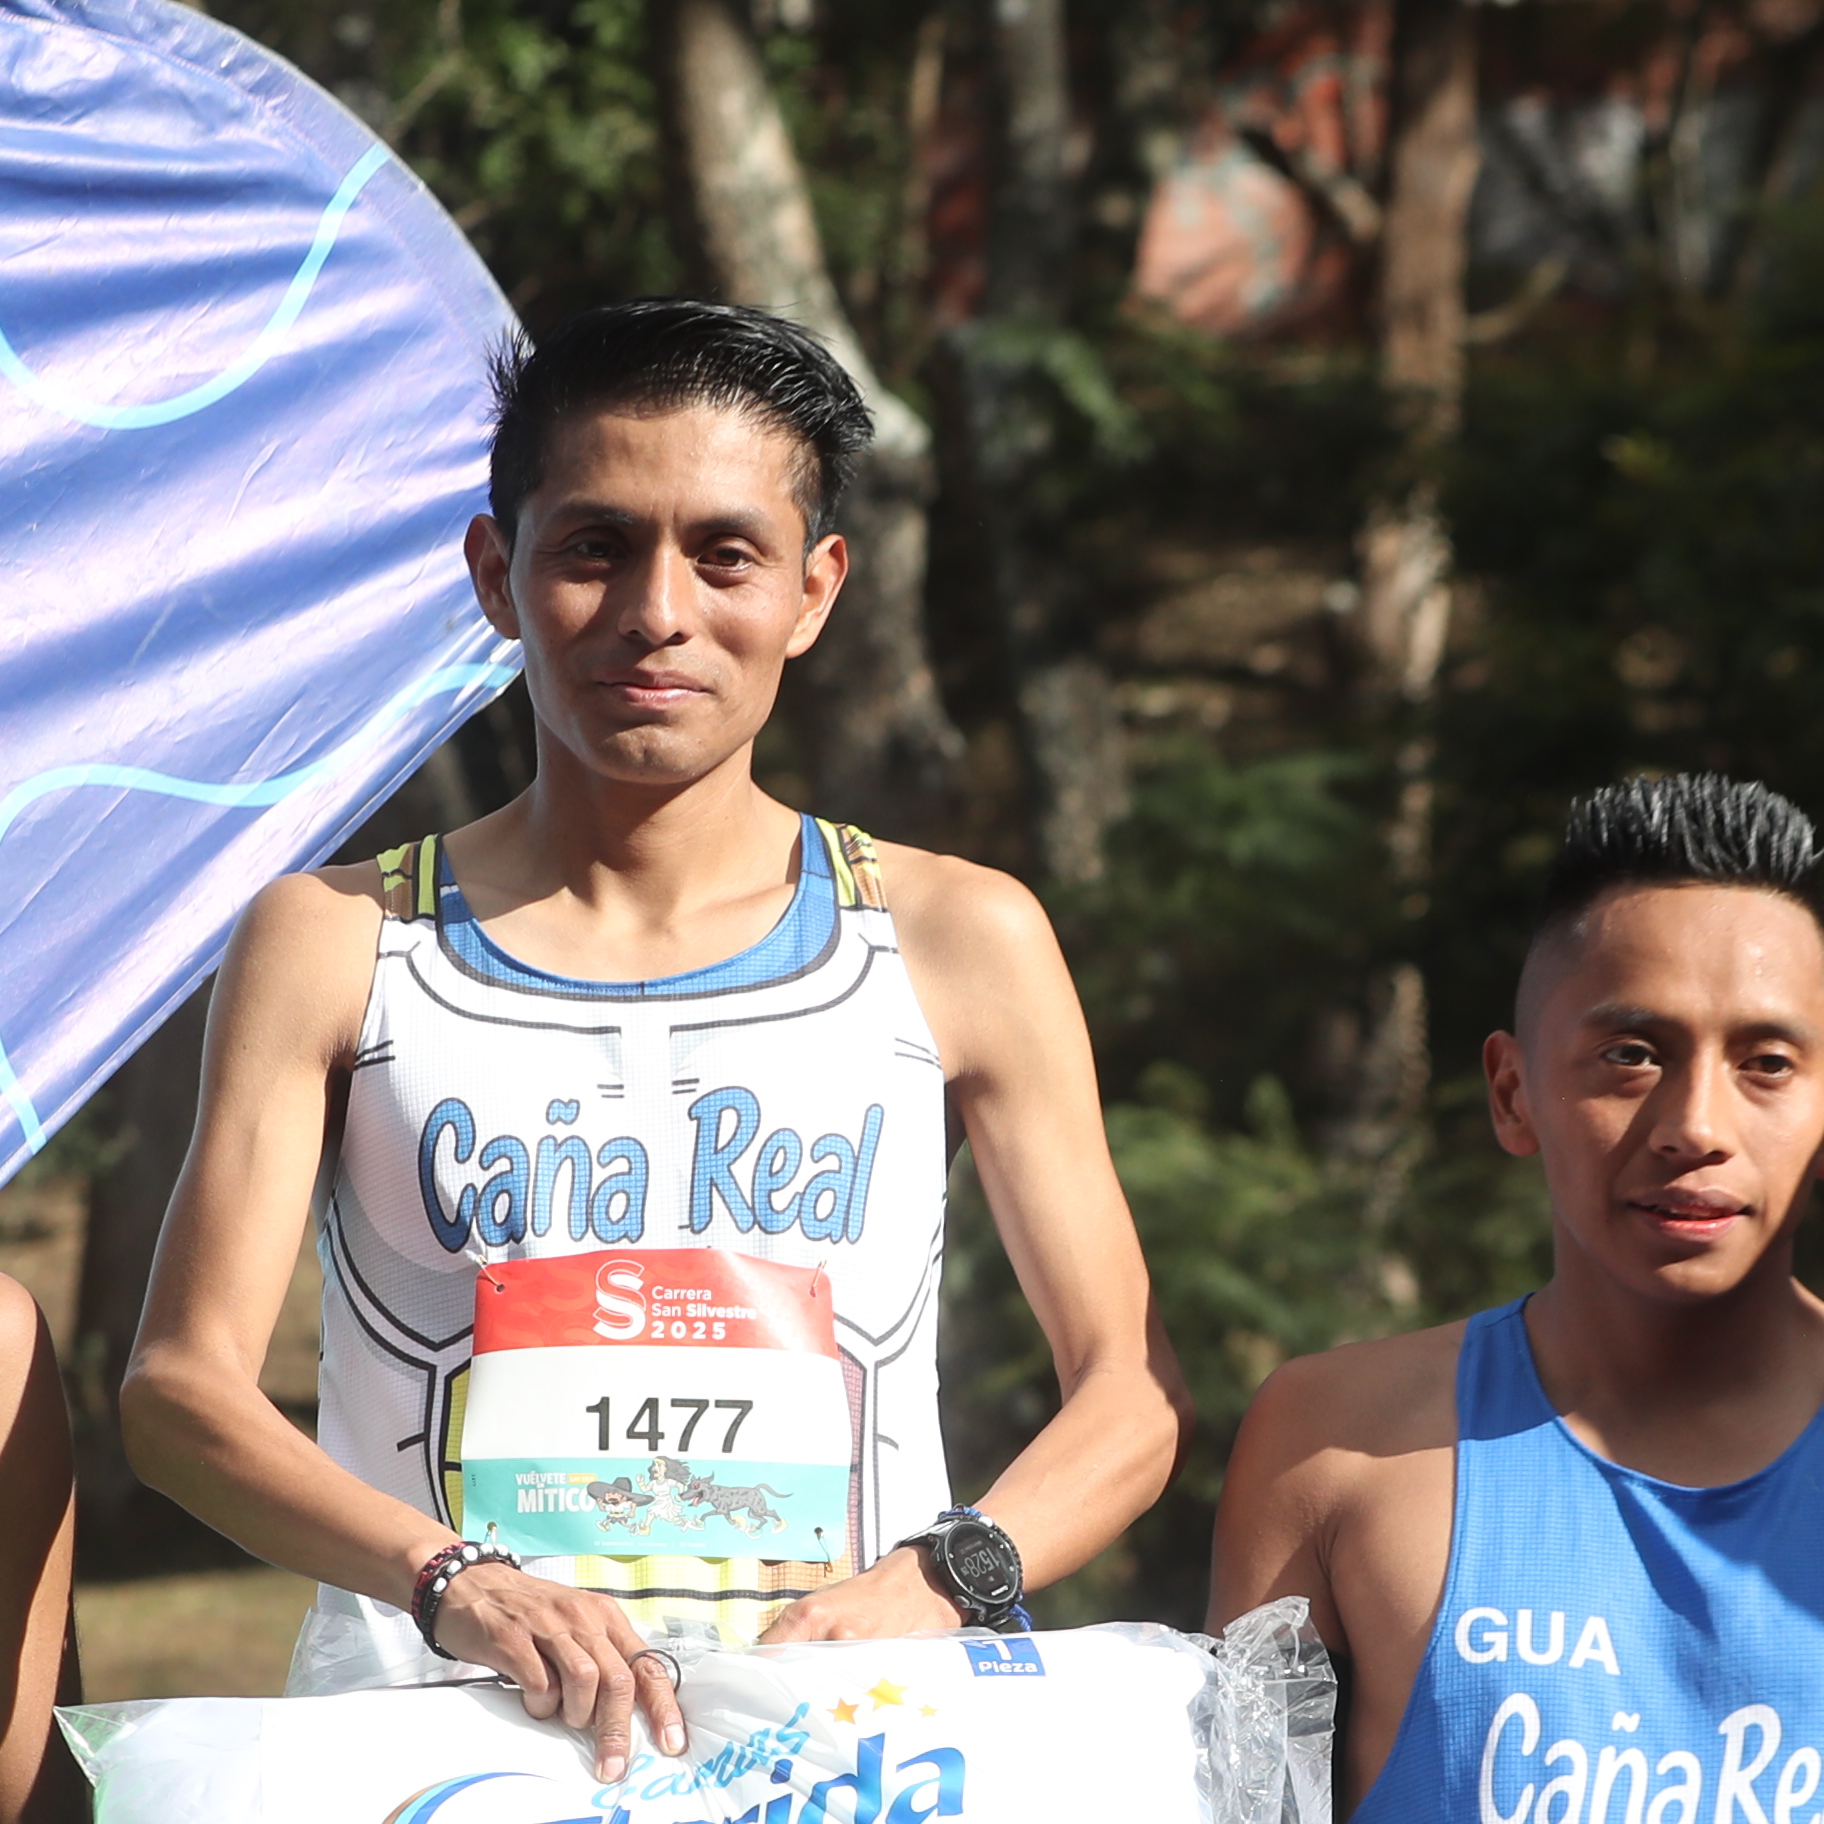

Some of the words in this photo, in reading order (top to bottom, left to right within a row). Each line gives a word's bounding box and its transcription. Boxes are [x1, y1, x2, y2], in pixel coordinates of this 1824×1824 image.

[419, 1098, 648, 1253] Caña
[688, 1086, 884, 1244] Real
[651, 1286, 712, 1301] Carrera
[651, 1303, 681, 1318] San
[685, 1303, 757, 1321] Silvestre
[651, 1320, 727, 1341] 2025
[585, 1397, 754, 1454] 1477
[515, 1471, 566, 1485] VUÉLVETE
[517, 1483, 596, 1513] MÍTICO
[1454, 1607, 1621, 1675] GUA
